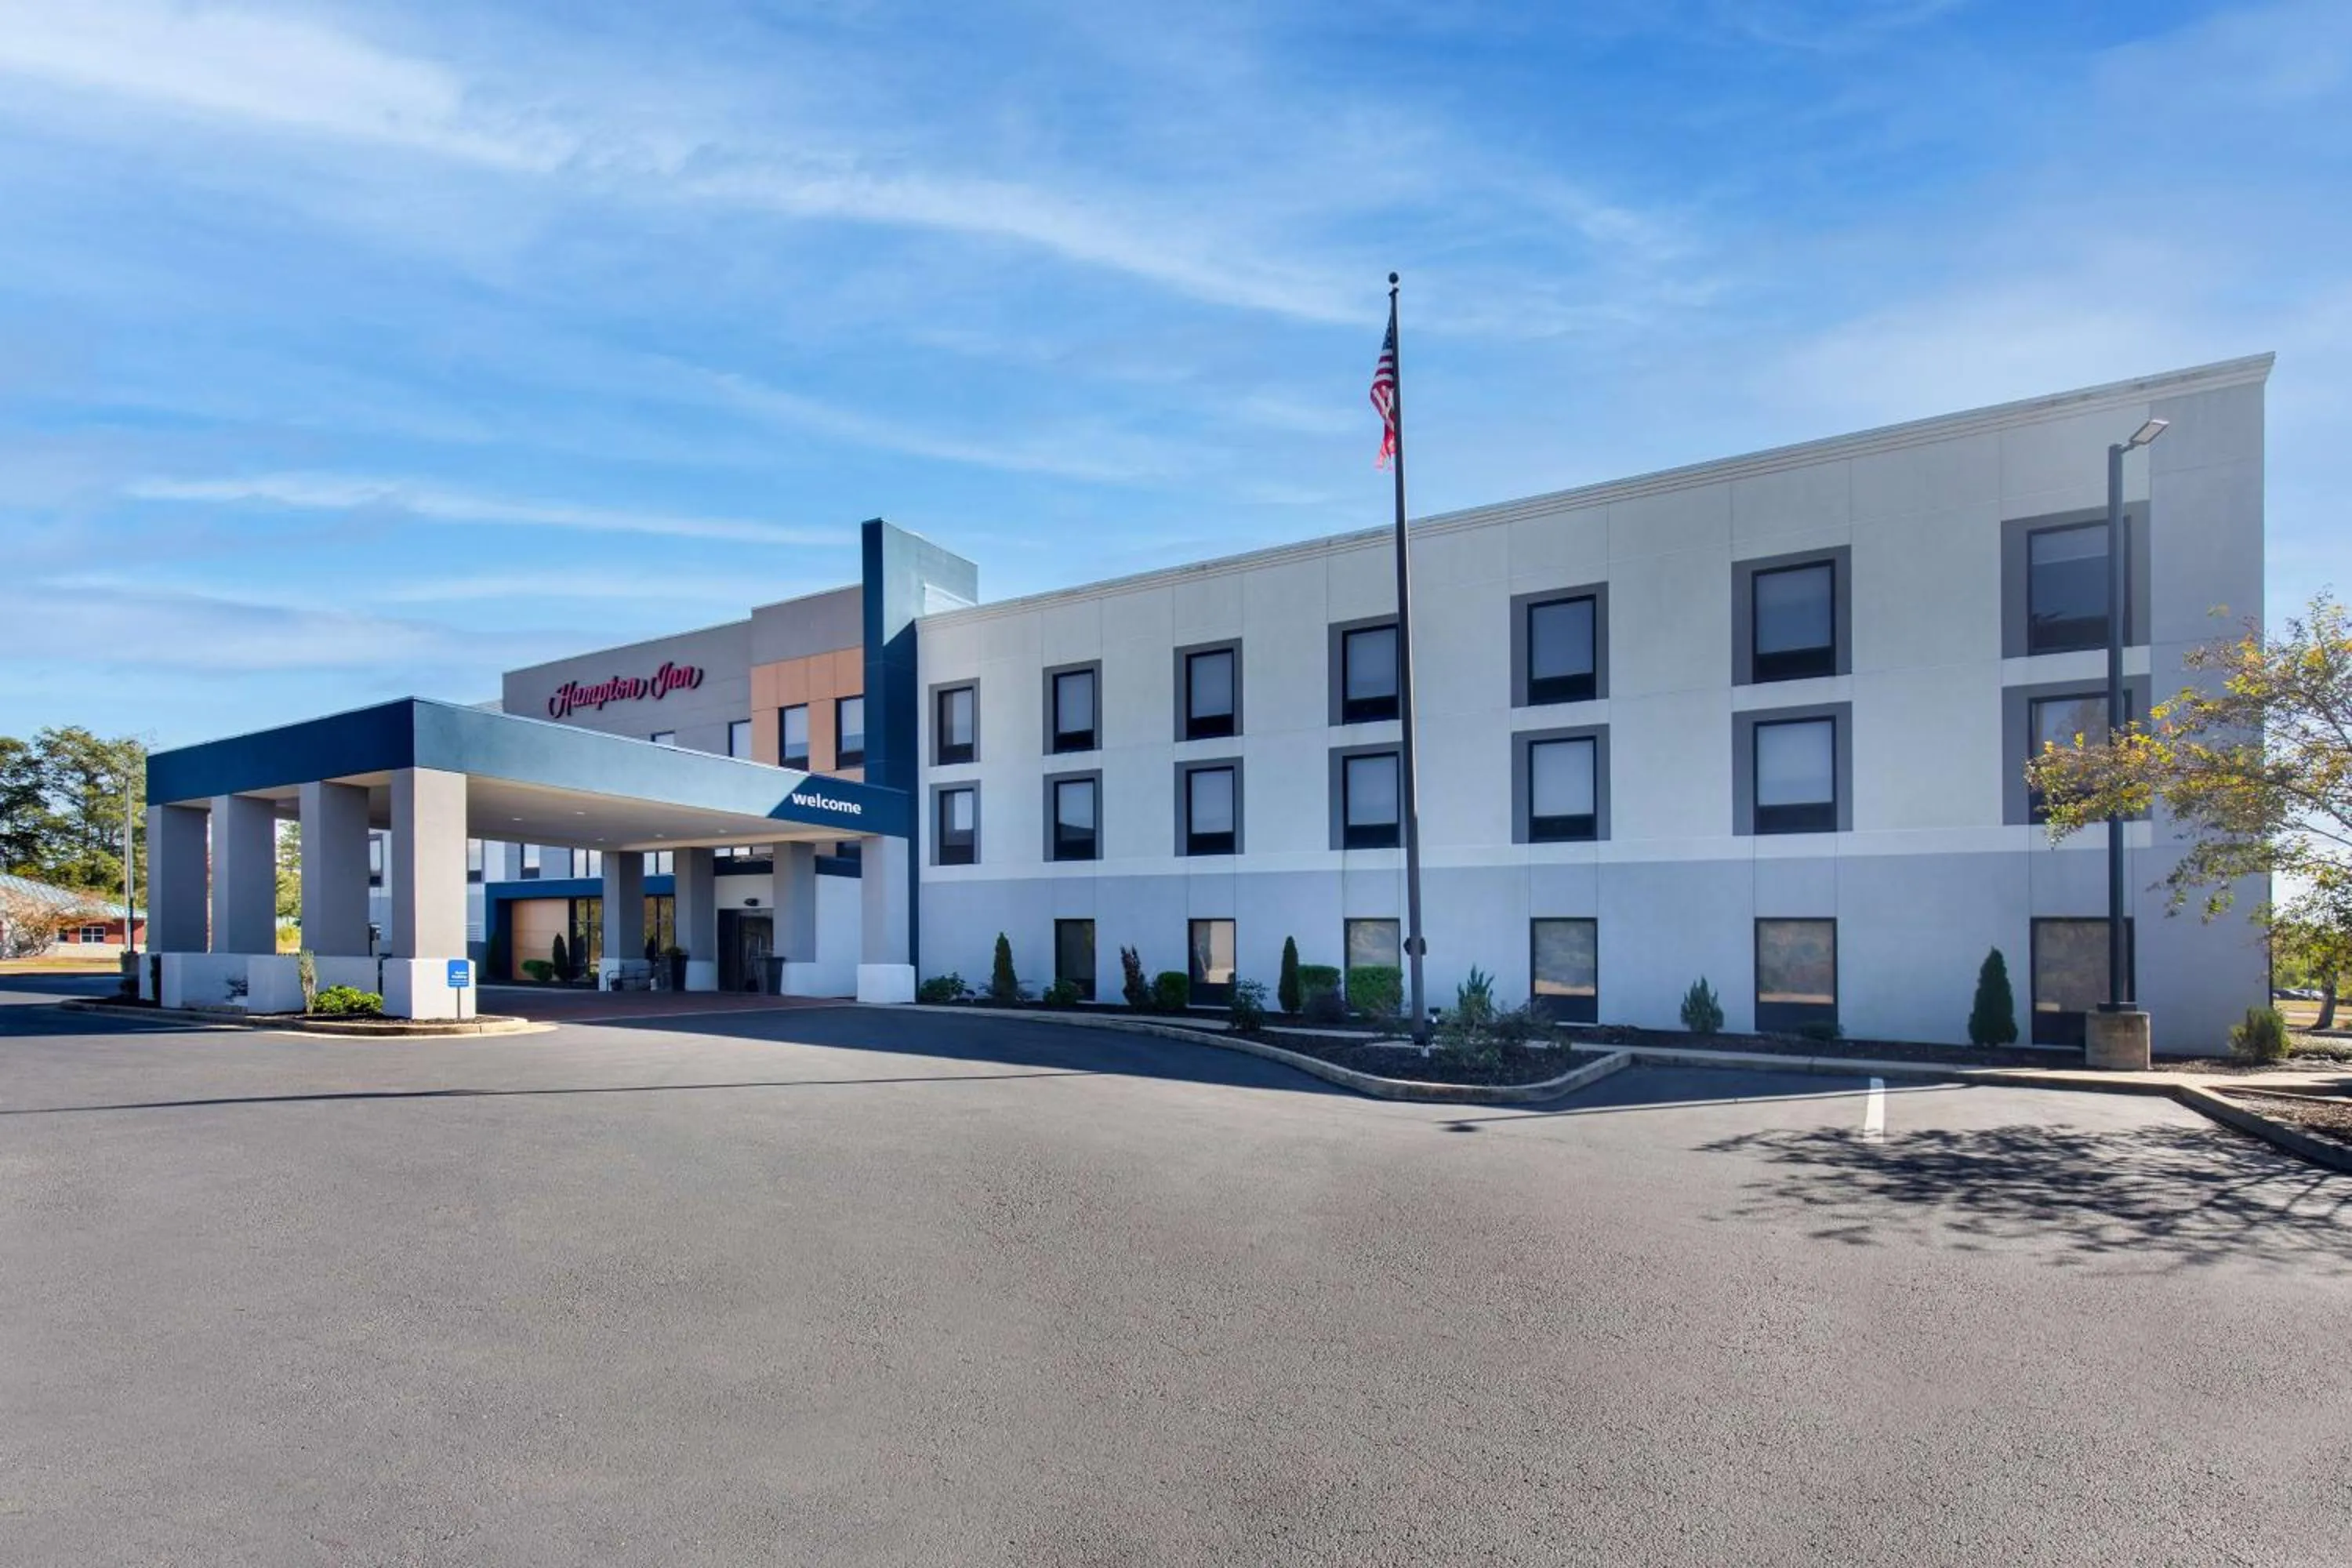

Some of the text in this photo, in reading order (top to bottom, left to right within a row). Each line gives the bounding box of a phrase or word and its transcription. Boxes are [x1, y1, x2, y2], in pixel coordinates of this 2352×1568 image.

[548, 662, 703, 718] Hampton Inn
[791, 793, 862, 815] welcome
